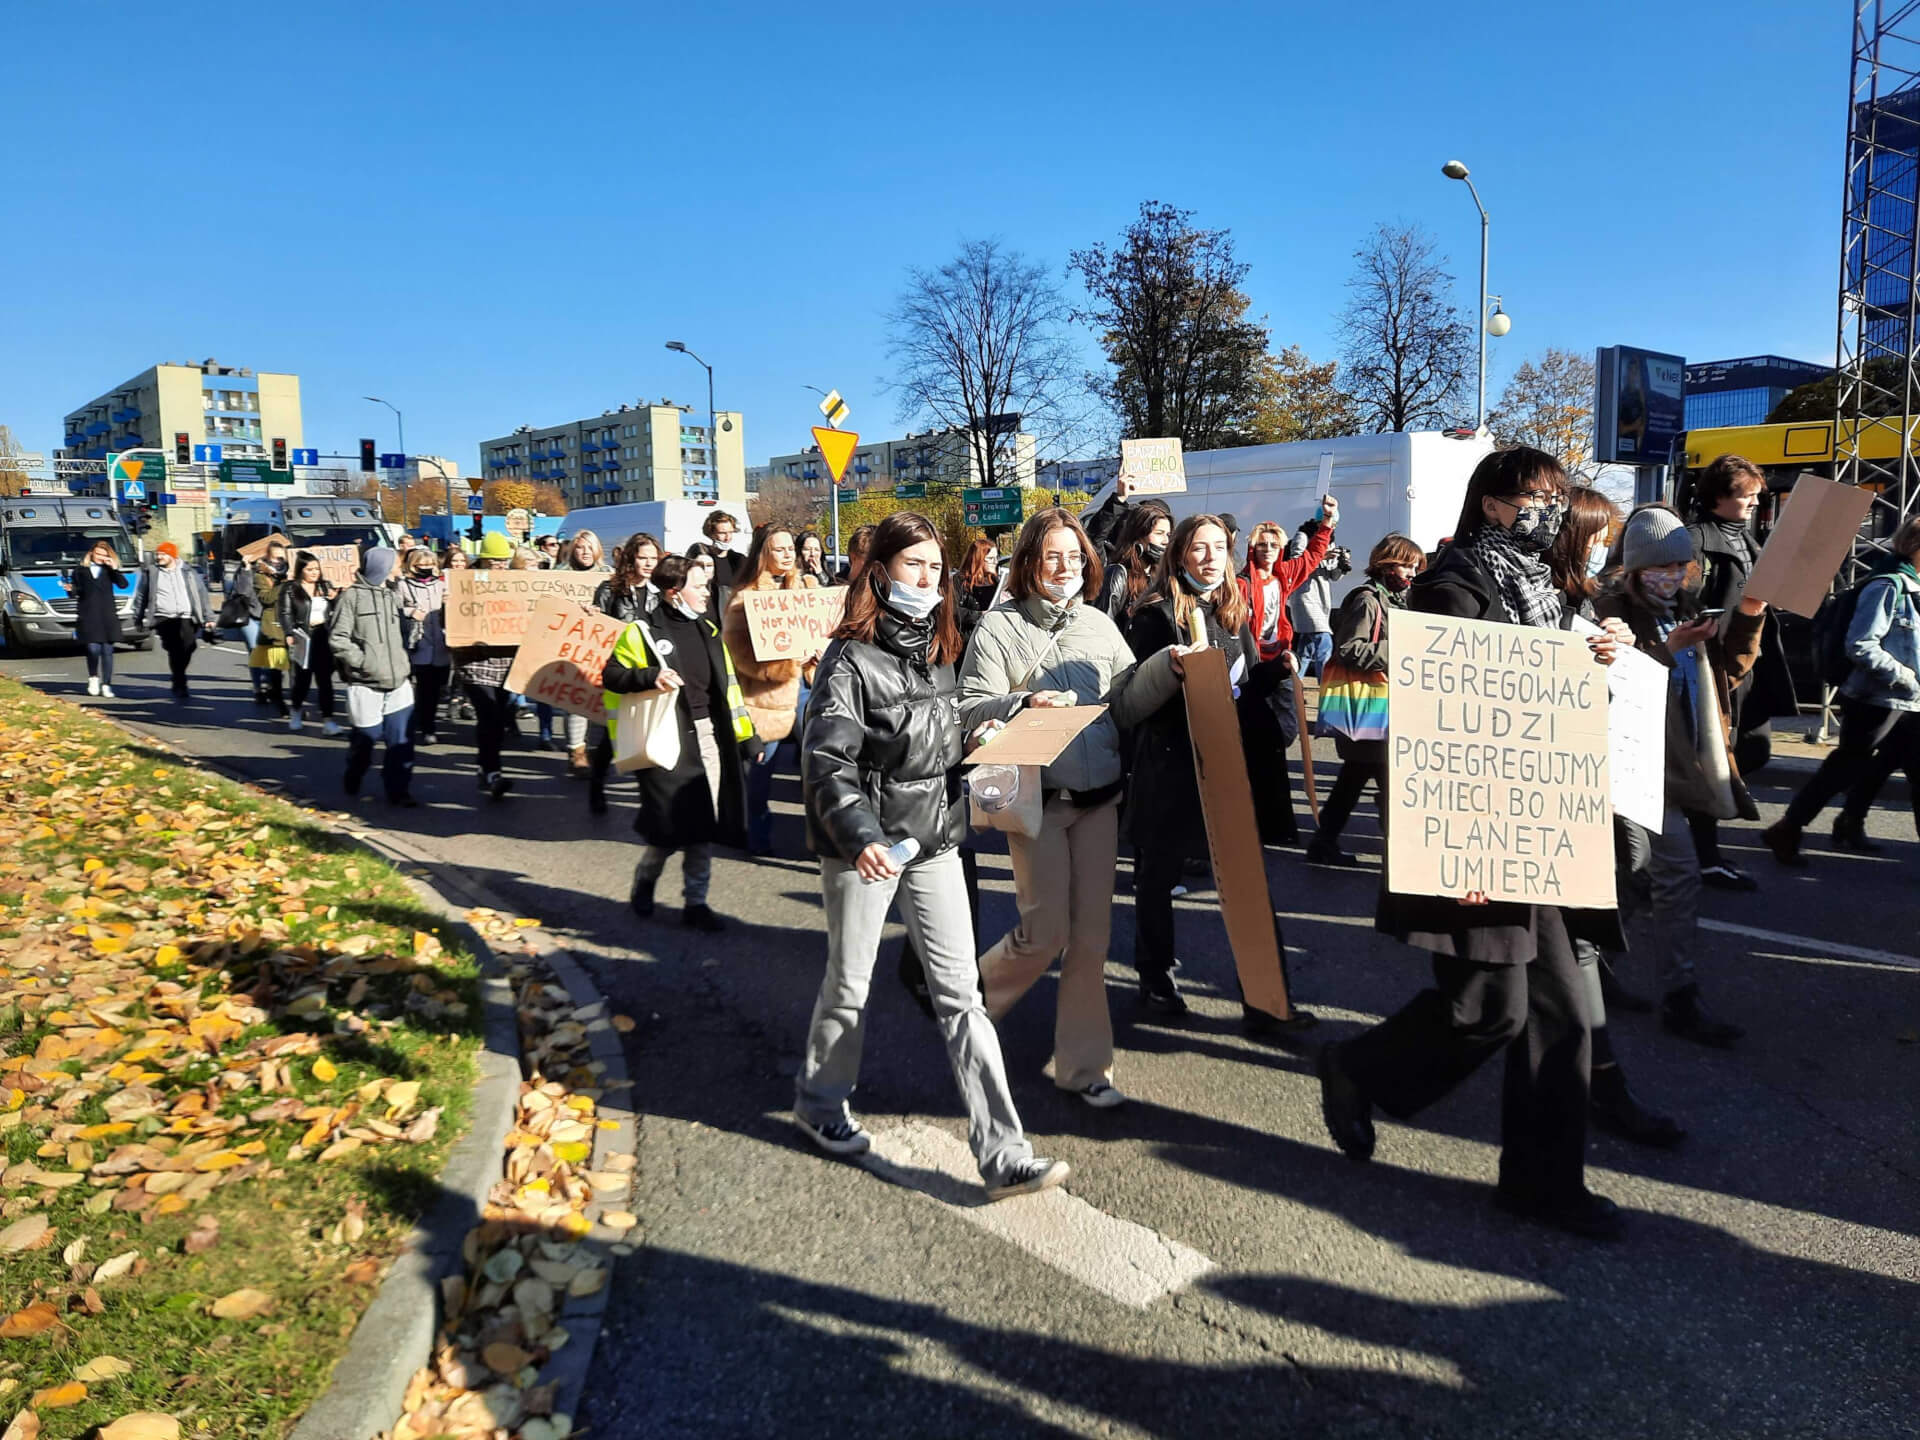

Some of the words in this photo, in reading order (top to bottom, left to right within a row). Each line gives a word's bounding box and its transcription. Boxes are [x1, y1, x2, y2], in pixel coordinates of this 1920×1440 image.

[512, 580, 529, 593] TO
[753, 595, 788, 613] FUCK
[793, 593, 816, 612] ME
[548, 613, 618, 649] JARA
[761, 616, 783, 630] NOT
[558, 642, 606, 671] BLAN
[1425, 625, 1565, 671] ZAMIAST
[1398, 656, 1592, 710] SEGREGOWAĆ
[1437, 699, 1555, 743] LUDZI
[1395, 736, 1606, 788] POSEGREGUJMY
[1402, 772, 1500, 818] ŚMIECI,
[1509, 787, 1545, 819] BO
[1559, 792, 1606, 825] NAM
[1424, 817, 1574, 858] PLANETA
[1441, 854, 1561, 896] UMIERA
